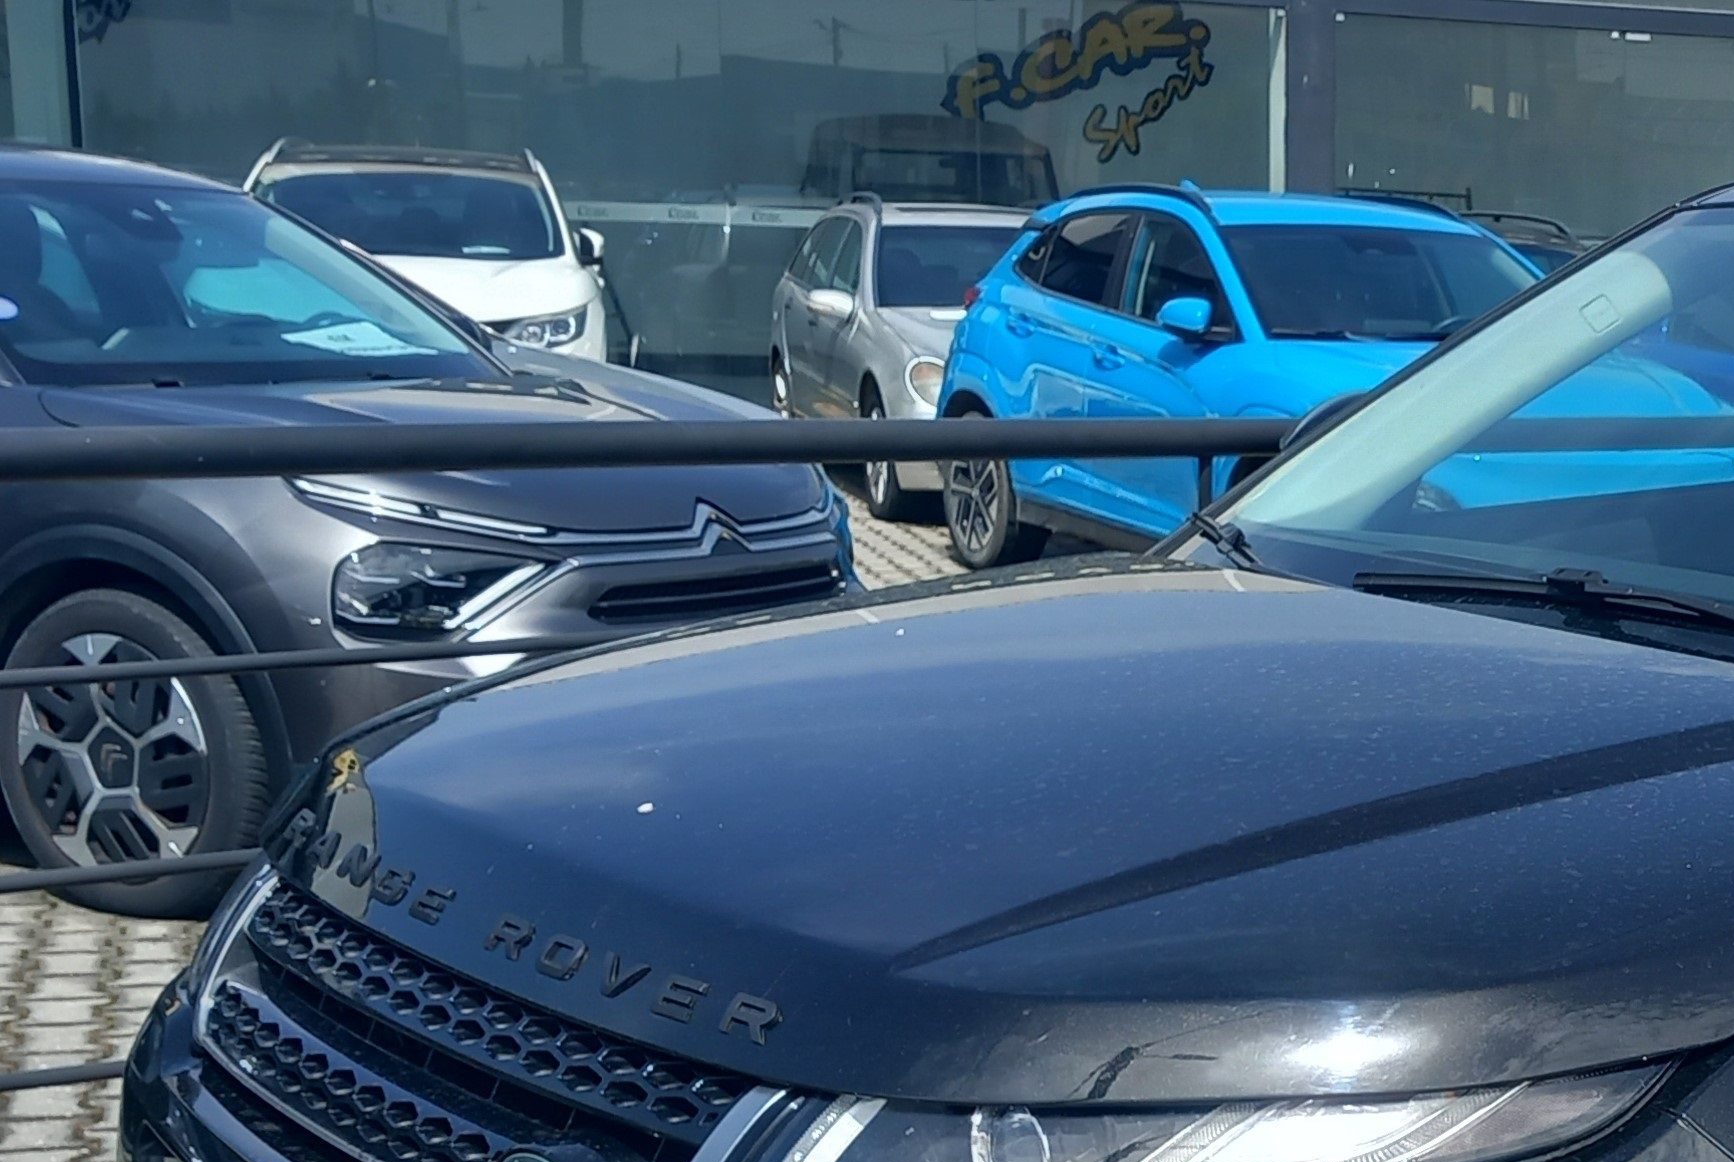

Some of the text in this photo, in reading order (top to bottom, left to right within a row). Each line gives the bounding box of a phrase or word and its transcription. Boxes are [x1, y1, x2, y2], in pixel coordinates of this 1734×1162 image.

[1083, 47, 1214, 163] Sport
[281, 807, 784, 1047] RANGE ROVER
